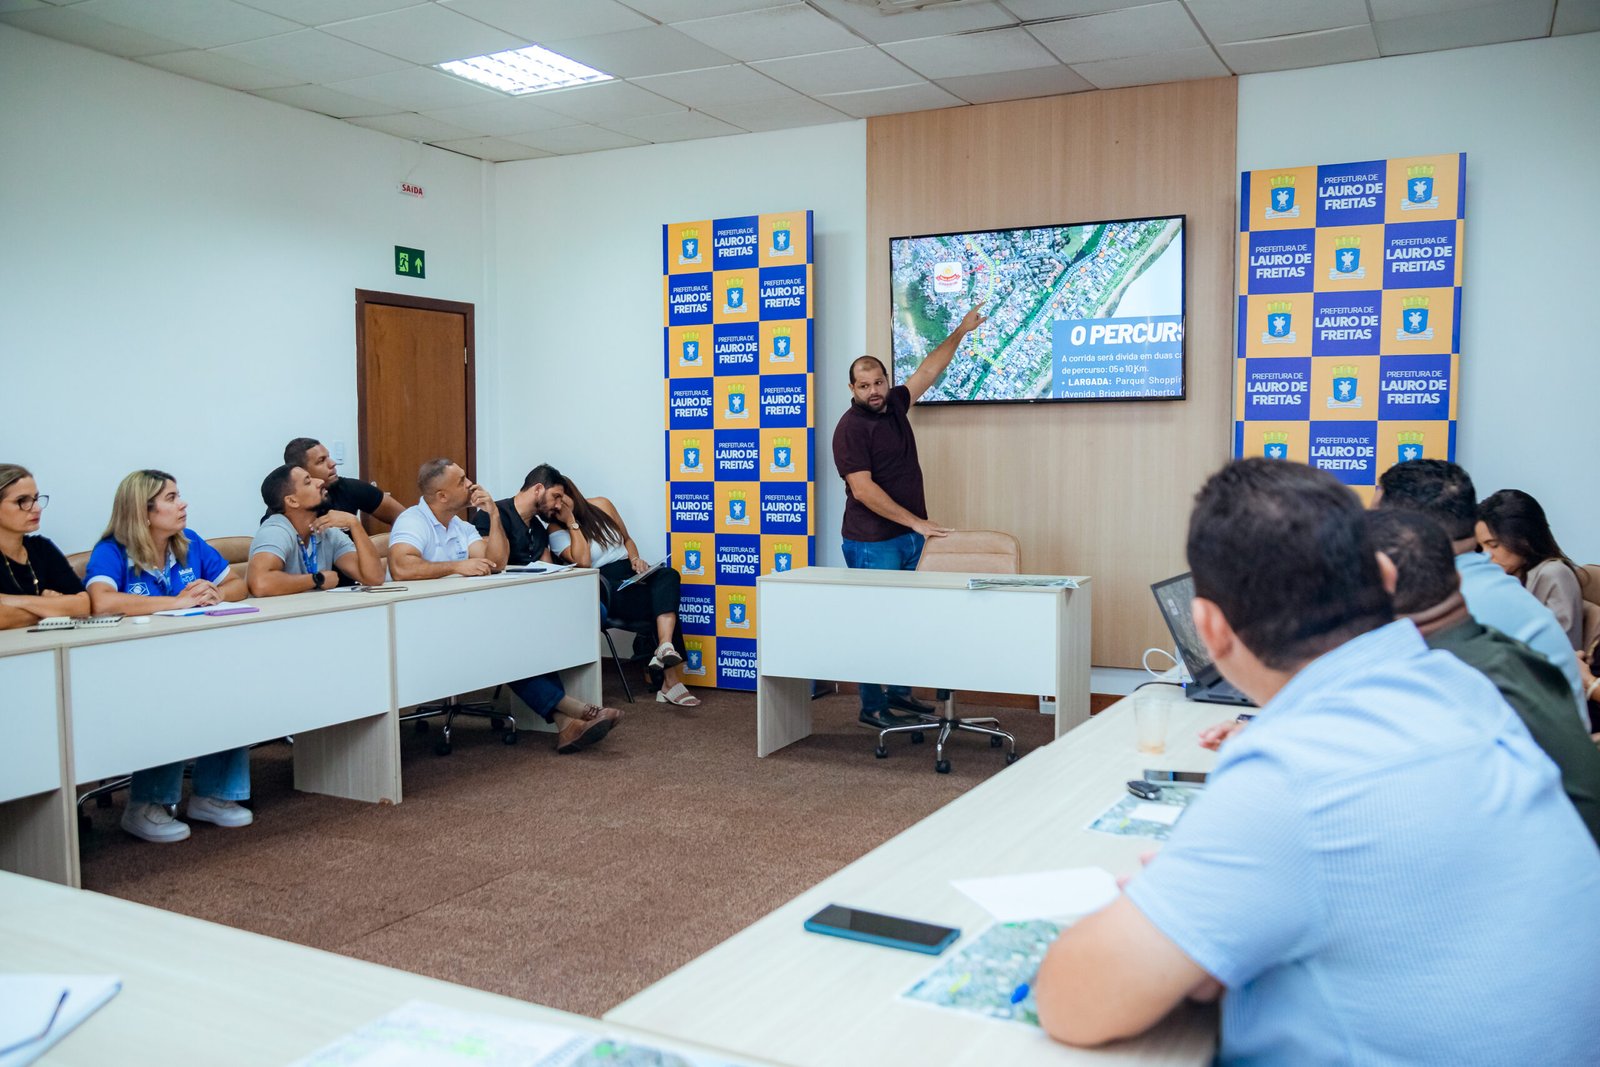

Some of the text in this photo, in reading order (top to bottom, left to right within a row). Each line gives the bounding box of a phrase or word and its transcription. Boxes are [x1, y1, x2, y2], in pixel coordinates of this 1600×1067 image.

[1324, 175, 1367, 184] PREFEITURA
[1319, 183, 1383, 197] LAURO DE
[1325, 197, 1376, 210] FREITAS
[715, 235, 757, 247] LAURO DE
[1392, 238, 1436, 246] PREFEITURA
[719, 246, 753, 257] FREITAS
[1386, 246, 1452, 260] LAURO DE
[1251, 254, 1311, 266] LAURO DE
[1392, 260, 1445, 272] FREITAS
[1256, 267, 1305, 279] FREITAS
[761, 286, 804, 297] LAURO DE
[670, 292, 711, 303] LAURO DE
[765, 297, 800, 308] FREITAS
[674, 304, 707, 314] FREITAS
[1316, 316, 1378, 327] LAURO DE
[1070, 326, 1086, 346] O
[1321, 329, 1371, 340] FREITAS
[715, 343, 757, 353] LAURO DE
[720, 354, 753, 364] FREITAS
[1072, 367, 1107, 375] percurso:
[1116, 377, 1145, 386] Parque
[1382, 380, 1447, 390] LAURO DE
[1247, 382, 1307, 392] LAURO DE
[1145, 389, 1175, 397] Alberto
[671, 398, 699, 406] LAURO
[761, 395, 805, 405] LAURO DE
[1253, 395, 1301, 405] FREITAS
[1387, 393, 1440, 404] FREITAS
[675, 408, 708, 417] FREITAS
[766, 406, 800, 415] FREITAS
[716, 450, 758, 458] LAURO DE
[1311, 446, 1374, 456] LAURO DE
[720, 461, 754, 469] FREITAS
[1317, 460, 1367, 470] FREITAS
[672, 502, 712, 510] LAURO DE
[762, 503, 805, 511] LAURO DE
[676, 512, 708, 521] FREITAS
[766, 513, 801, 522] FREITAS
[717, 554, 759, 563] LAURO DE
[721, 564, 755, 574] FREITAS
[679, 604, 714, 614] AURO DE
[718, 657, 747, 667] LAURO
[722, 668, 756, 679] FREITAS
